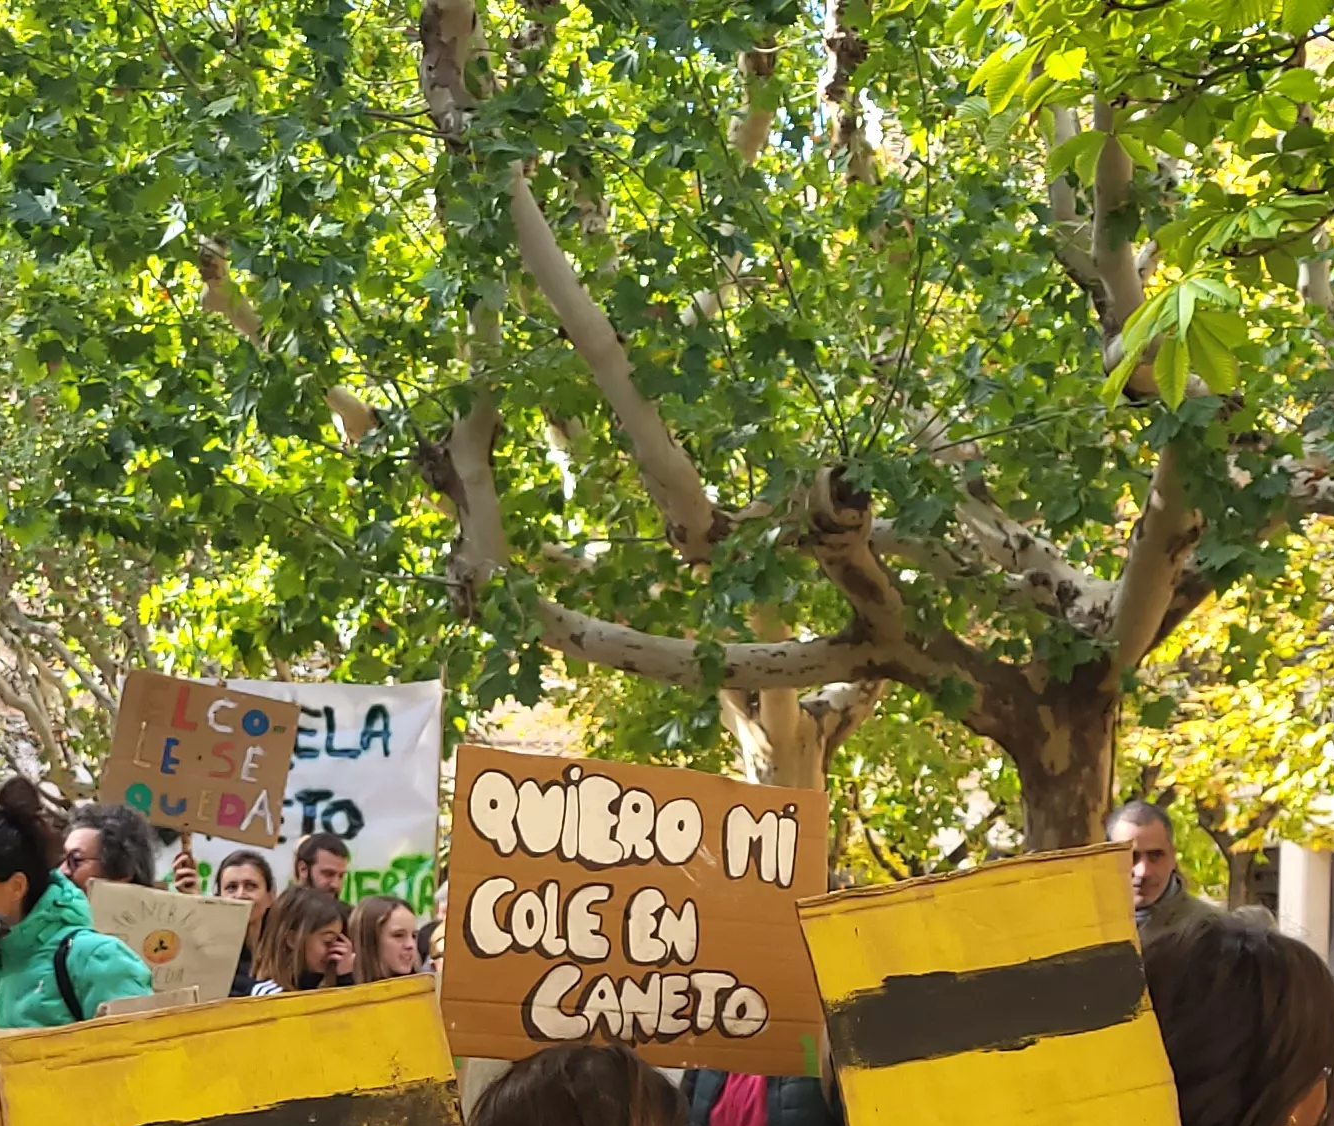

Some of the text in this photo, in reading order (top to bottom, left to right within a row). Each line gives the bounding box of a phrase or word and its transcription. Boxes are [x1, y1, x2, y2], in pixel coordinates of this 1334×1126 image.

[209, 742, 265, 783] SE
[125, 781, 274, 836] QUEDA
[278, 788, 365, 840] TO
[463, 876, 700, 967] COLE EN
[521, 962, 769, 1049] CANETO
